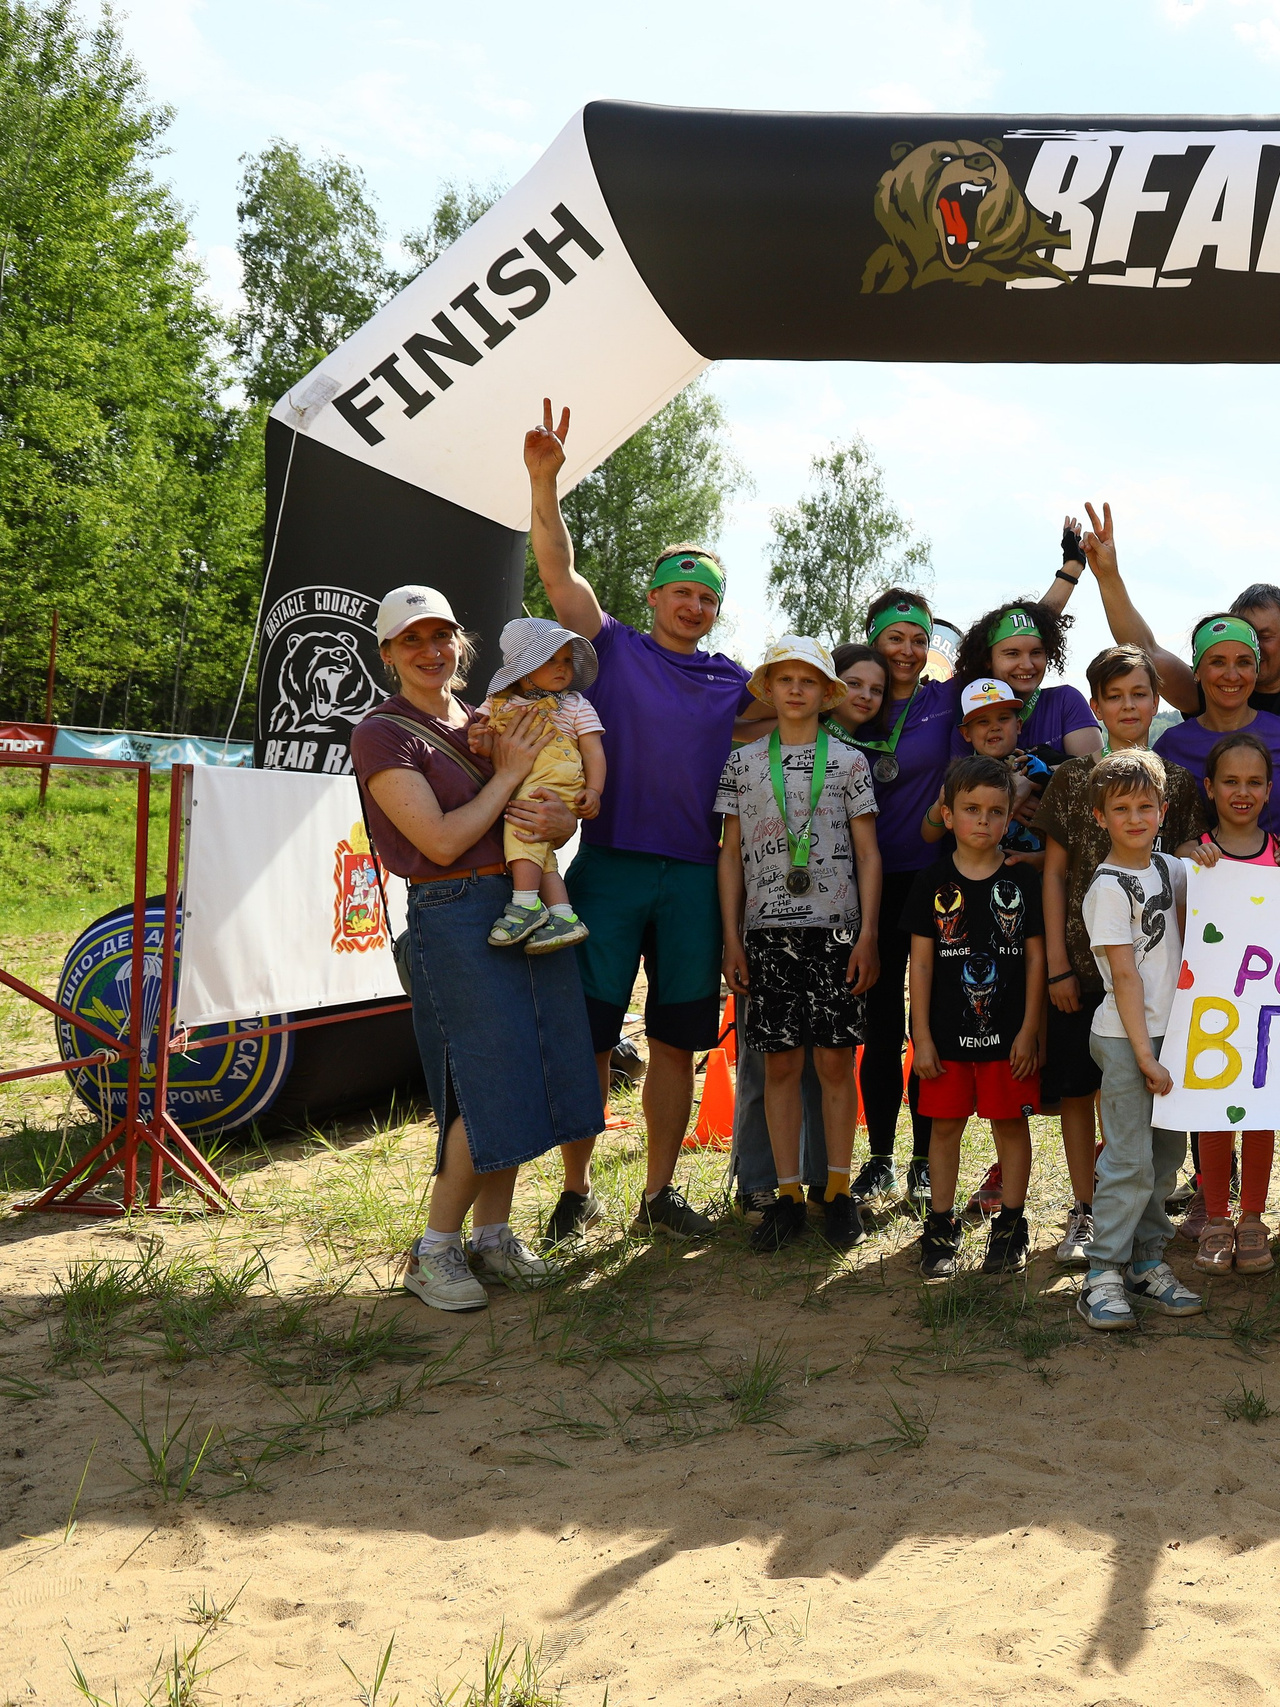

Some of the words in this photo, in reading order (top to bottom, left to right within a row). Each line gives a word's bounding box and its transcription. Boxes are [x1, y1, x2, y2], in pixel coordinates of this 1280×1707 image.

[332, 201, 605, 448] FINISH
[265, 593, 307, 640] OBSTACLE
[315, 591, 369, 621] COURSE
[1009, 613, 1036, 629] 111
[263, 739, 319, 770] BEAR
[754, 833, 820, 864] LEGED
[768, 885, 786, 894] LOO
[777, 892, 798, 900] INT
[769, 899, 792, 908] THE
[771, 904, 813, 915] FUTURE
[998, 946, 1024, 956] RIOT
[958, 1033, 1001, 1048] VENOM
